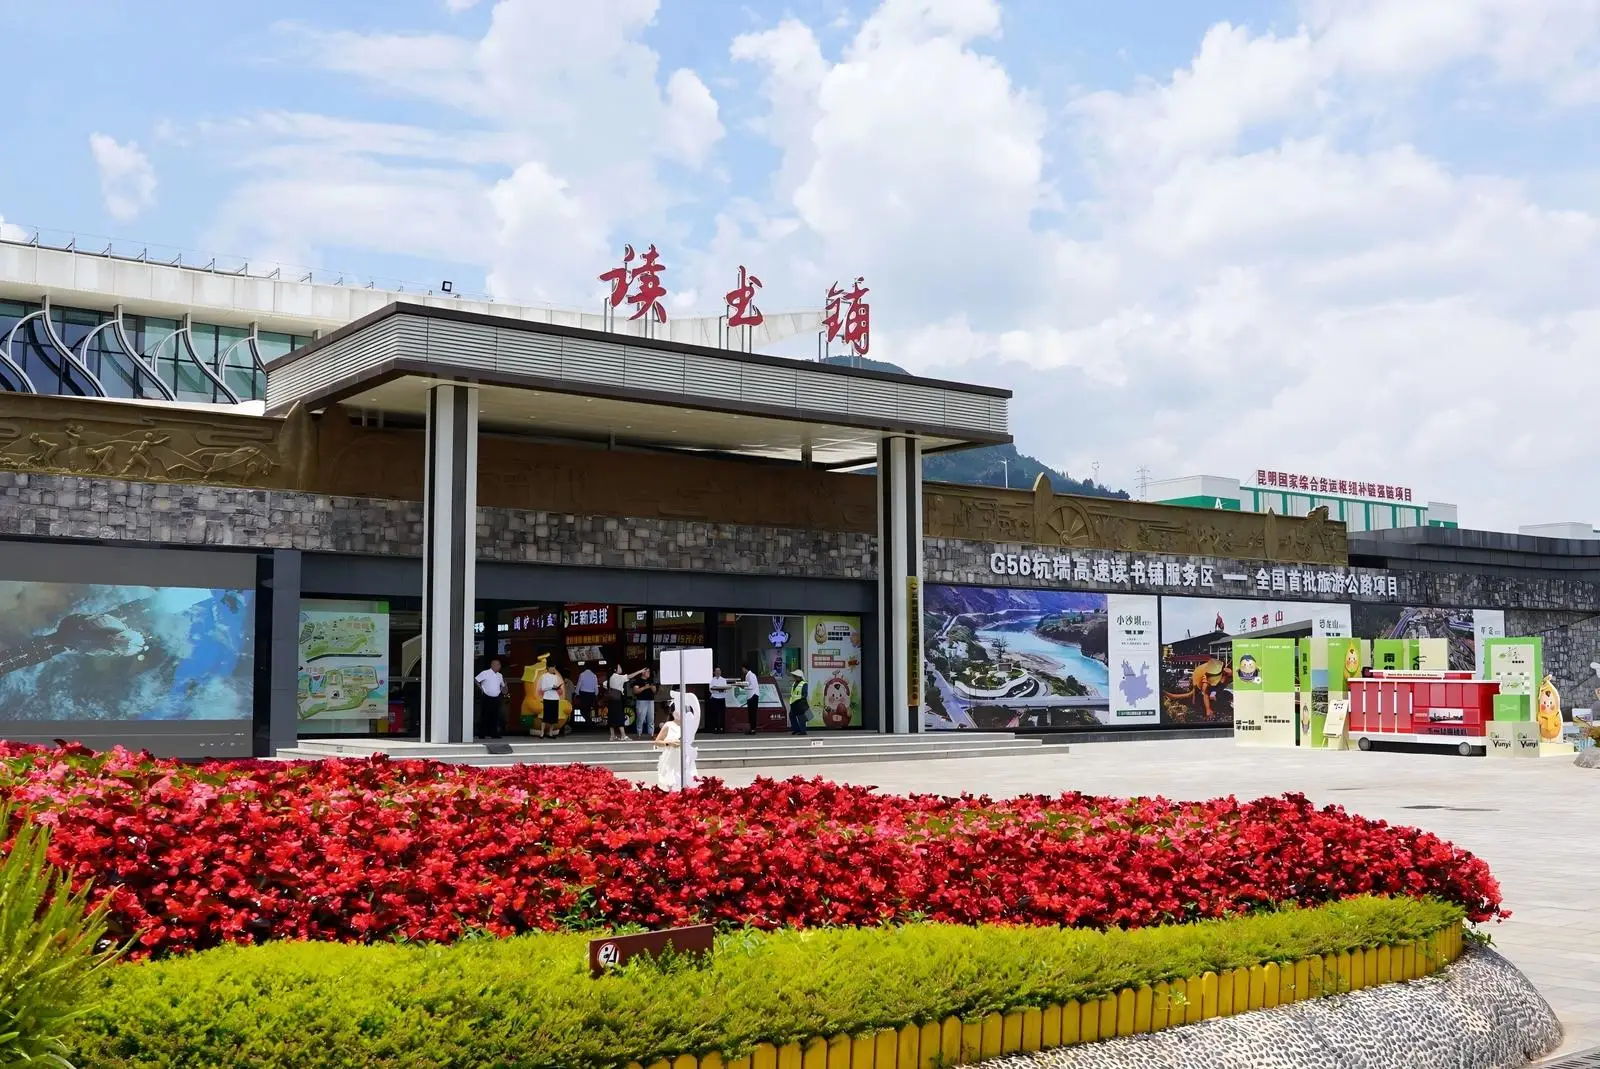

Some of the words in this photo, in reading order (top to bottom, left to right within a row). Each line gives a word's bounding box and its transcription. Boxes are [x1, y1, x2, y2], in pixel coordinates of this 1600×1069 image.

[599, 243, 870, 354] 读书铺
[1257, 469, 1412, 502] 昆明国家综合货运枢纽补链强链项目
[1255, 567, 1397, 597] 全国首批旅游公路项目
[570, 608, 608, 627] 正新鸡排
